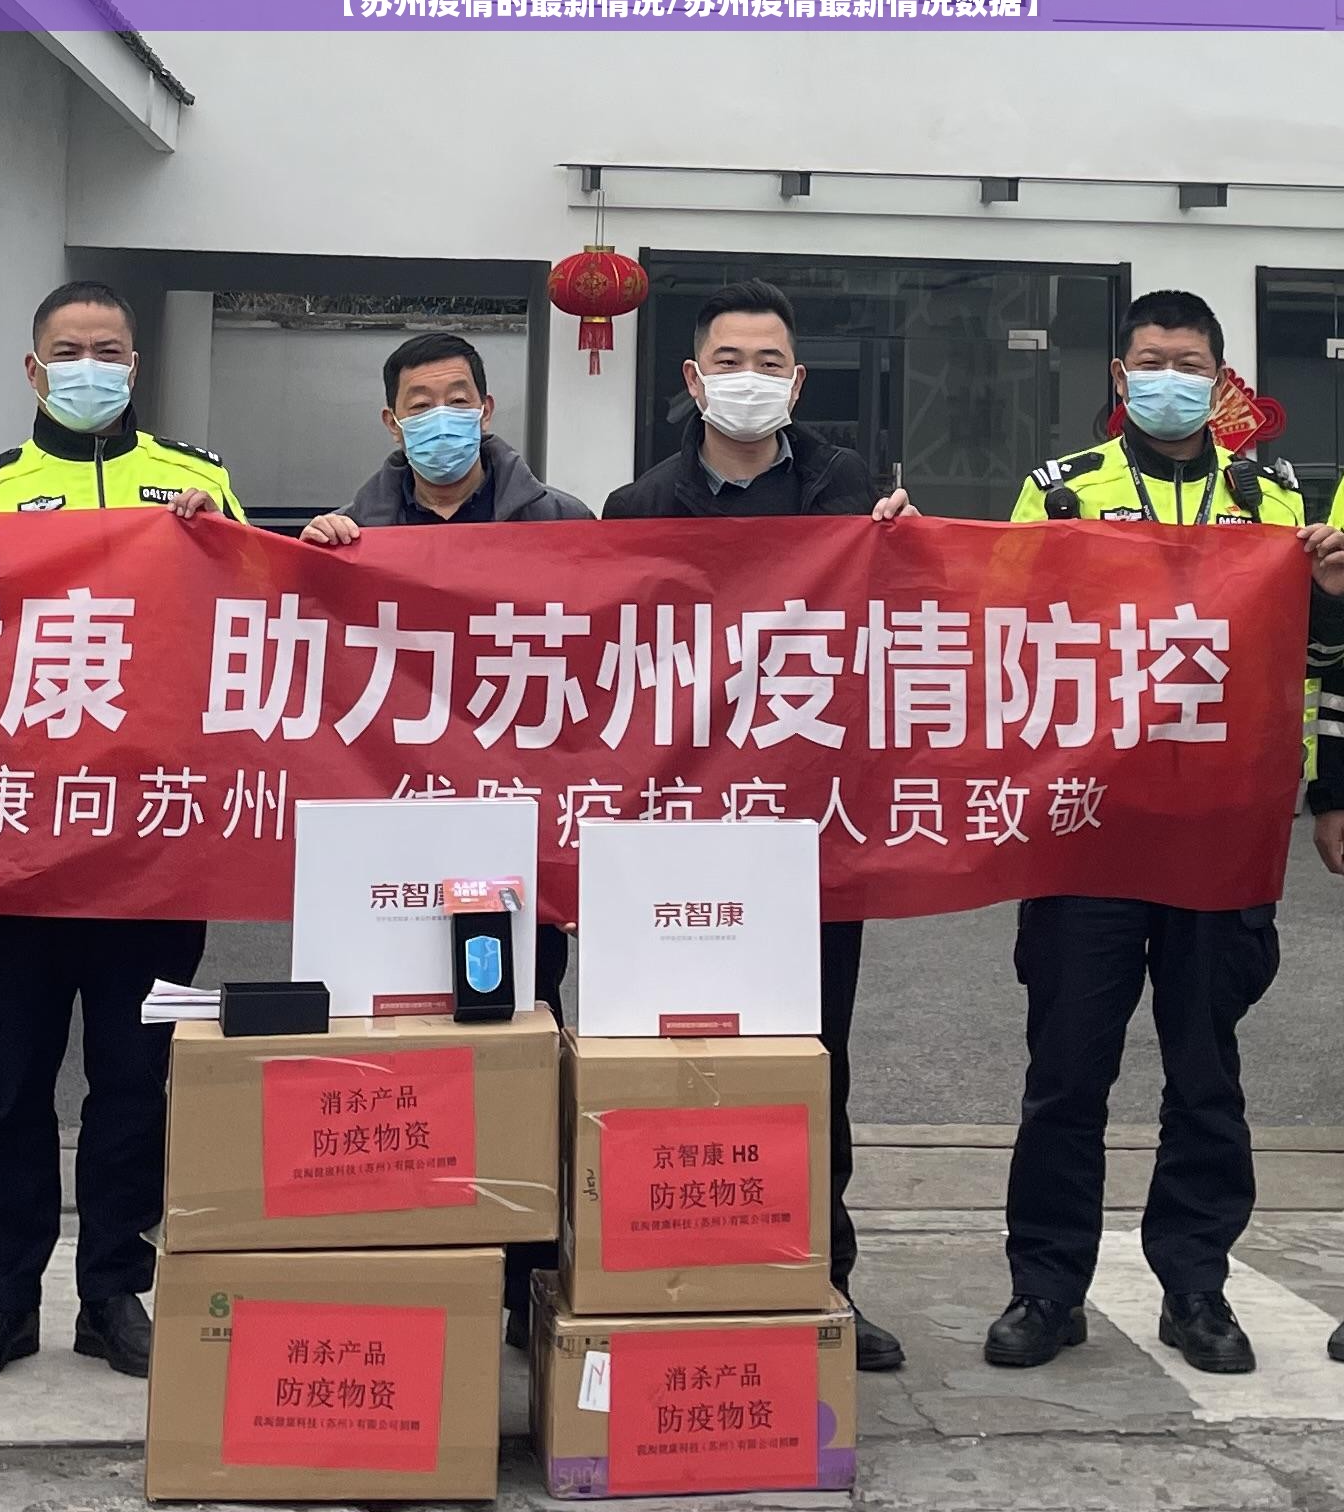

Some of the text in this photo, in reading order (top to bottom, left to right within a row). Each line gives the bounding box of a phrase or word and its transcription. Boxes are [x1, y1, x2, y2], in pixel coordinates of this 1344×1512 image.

[202, 594, 1230, 750] 助力苏州疫情防控
[653, 901, 745, 928] 京智康
[320, 1085, 418, 1115] 消杀产品
[313, 1120, 431, 1157] 防疫物资
[652, 1141, 759, 1169] 京智康 H8
[650, 1177, 764, 1211] 防疫物资
[287, 1339, 386, 1366] 消杀产品
[276, 1376, 396, 1410] 防疫物资
[664, 1362, 762, 1392] 消杀产品
[657, 1399, 773, 1434] 防疫物资
